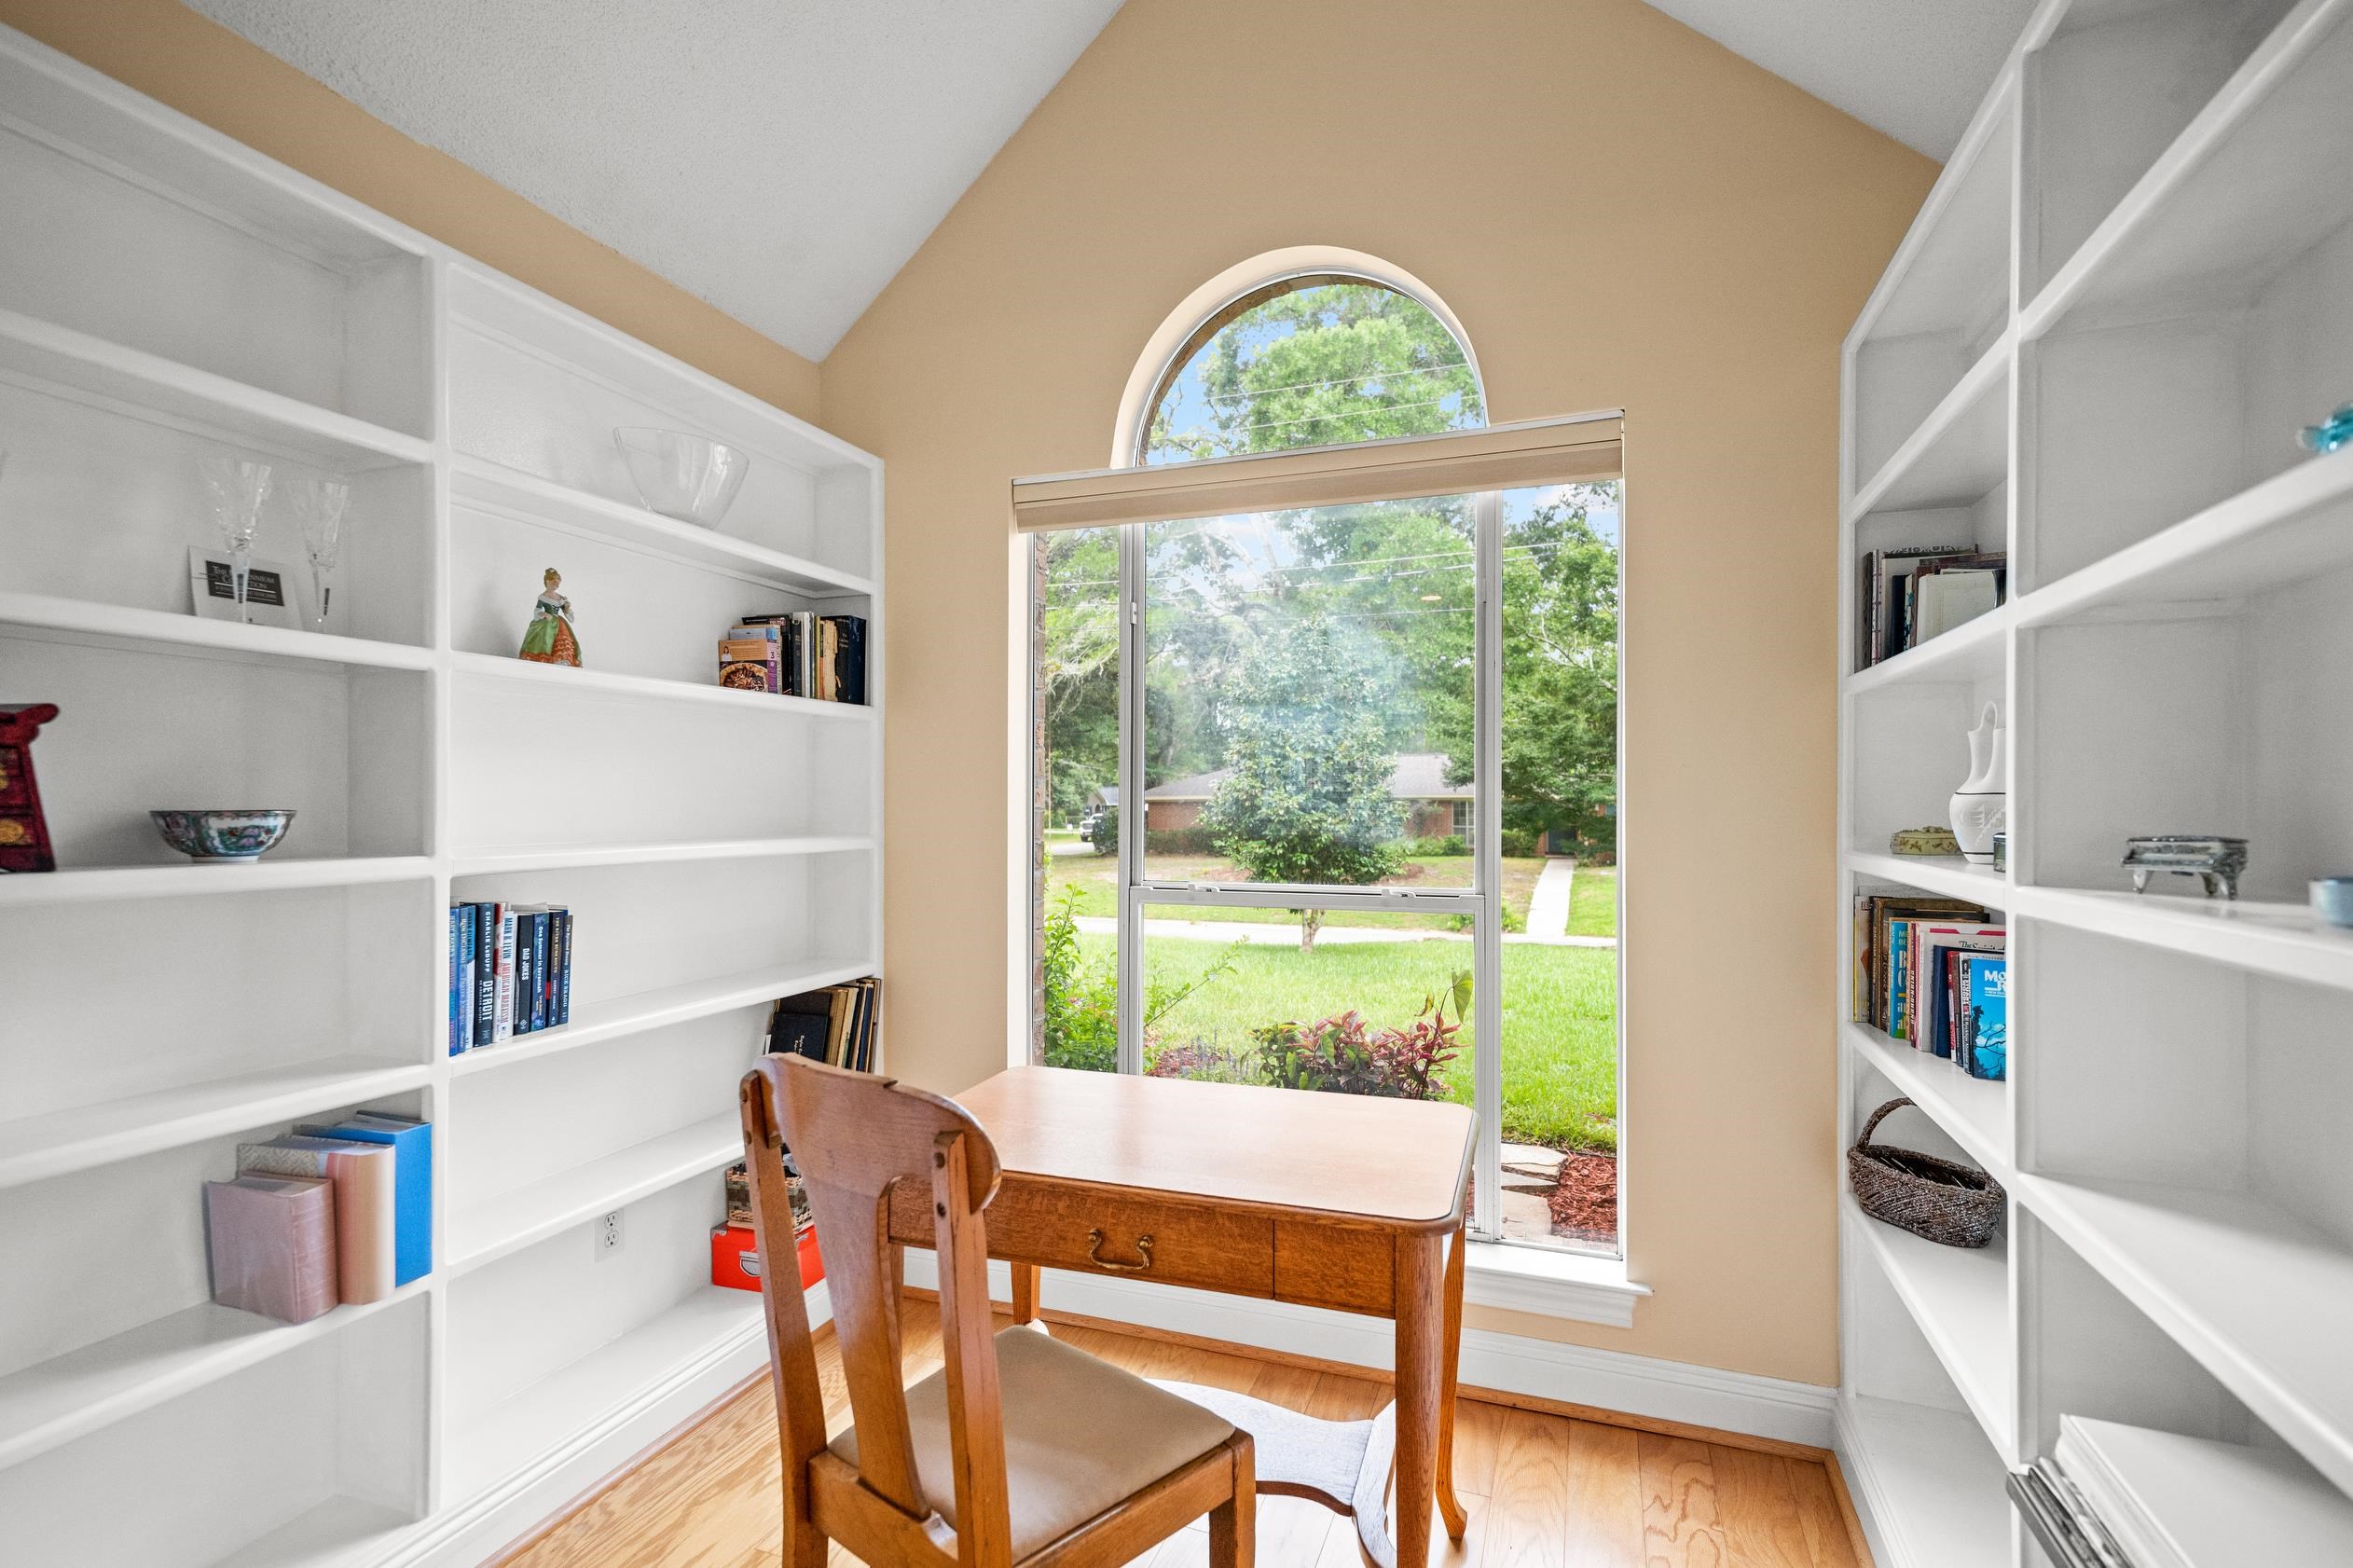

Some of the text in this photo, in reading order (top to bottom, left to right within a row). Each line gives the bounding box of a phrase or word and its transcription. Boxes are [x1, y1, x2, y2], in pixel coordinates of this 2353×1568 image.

[503, 942, 513, 959] LEVIN
[502, 963, 511, 994] AMERICAN
[483, 981, 494, 1022] DETROIT
[500, 995, 510, 1024] MARXISM
